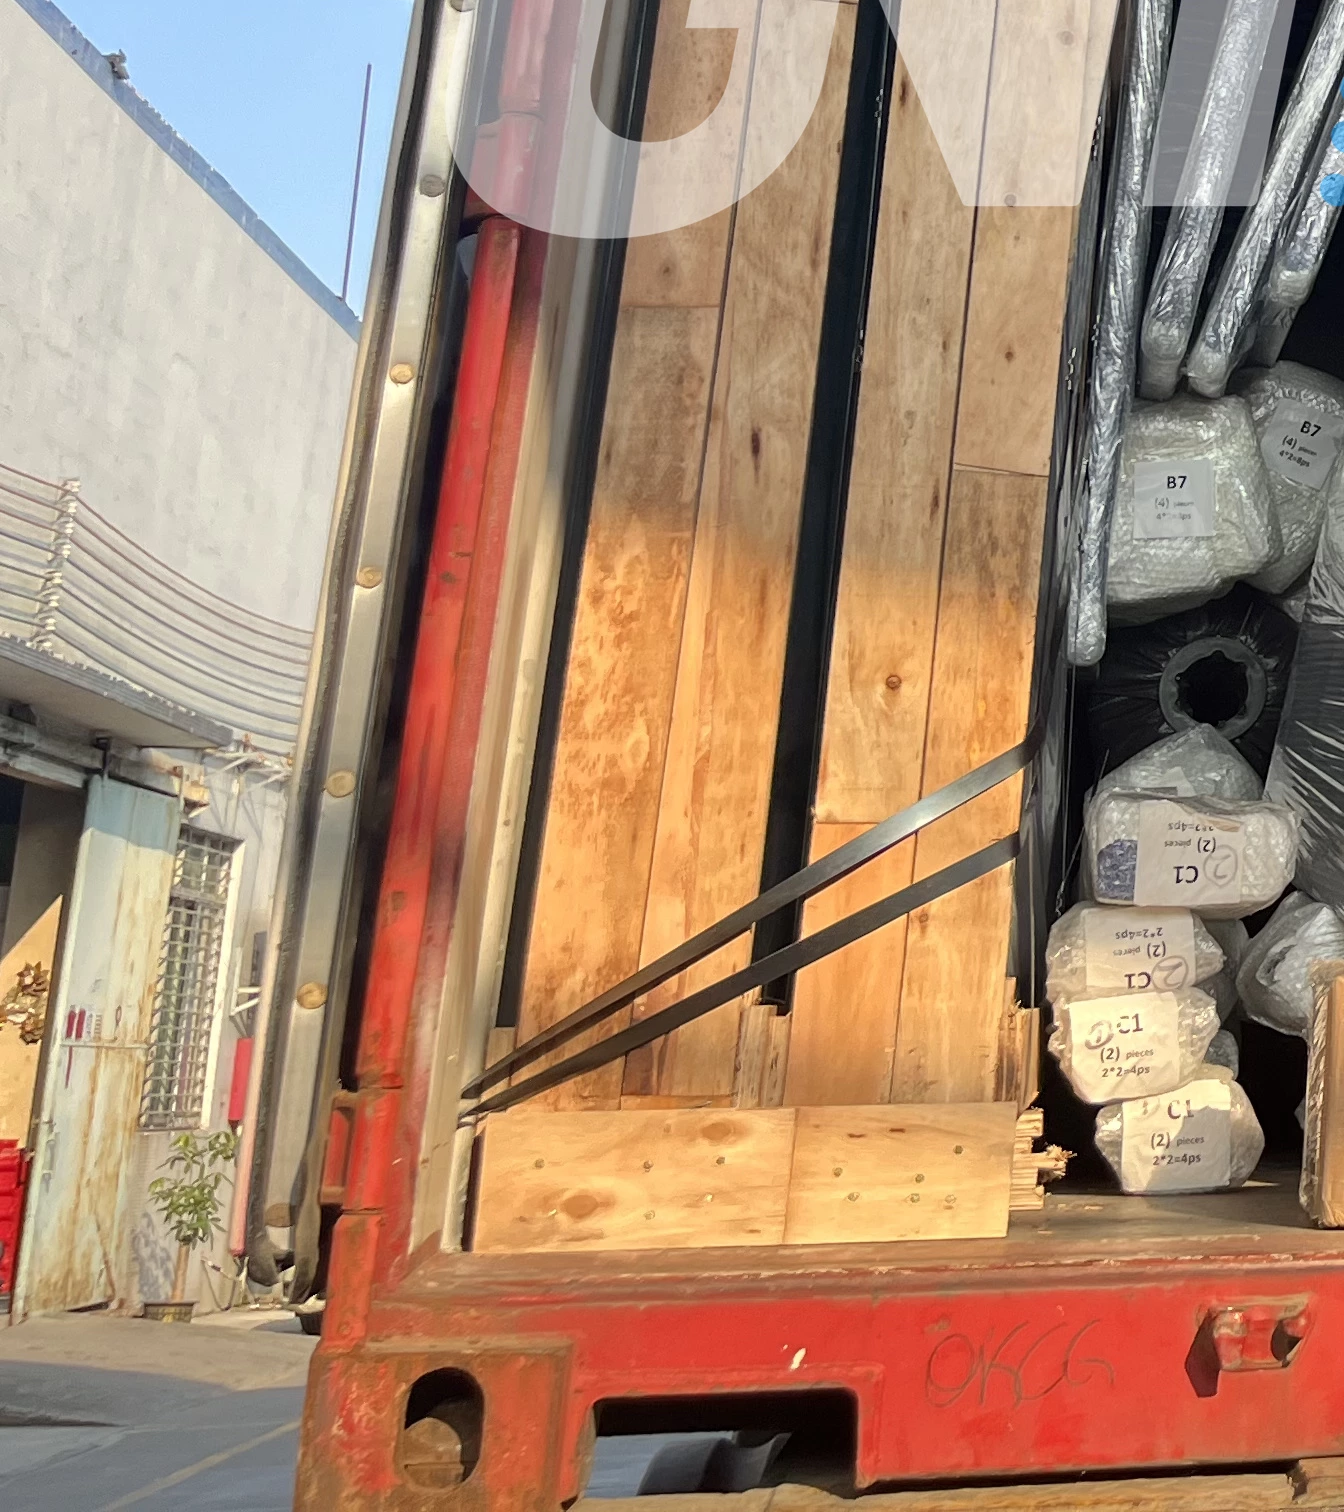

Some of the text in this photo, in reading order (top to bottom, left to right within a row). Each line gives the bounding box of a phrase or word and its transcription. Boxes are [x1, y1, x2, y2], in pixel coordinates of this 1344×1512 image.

[1300, 420, 1322, 437] B7
[1282, 435, 1297, 450] (4)
[1166, 475, 1188, 489] B7
[1154, 497, 1170, 509] (4)
[1164, 836, 1216, 854] (2) pieces
[1173, 865, 1199, 884] C1
[1147, 941, 1167, 959] (2)
[1124, 971, 1152, 989] C1
[1117, 1013, 1144, 1034] C1
[1100, 1046, 1154, 1064] (2) pieces
[1167, 1099, 1195, 1120] C1
[1151, 1132, 1205, 1150] (2) pieces
